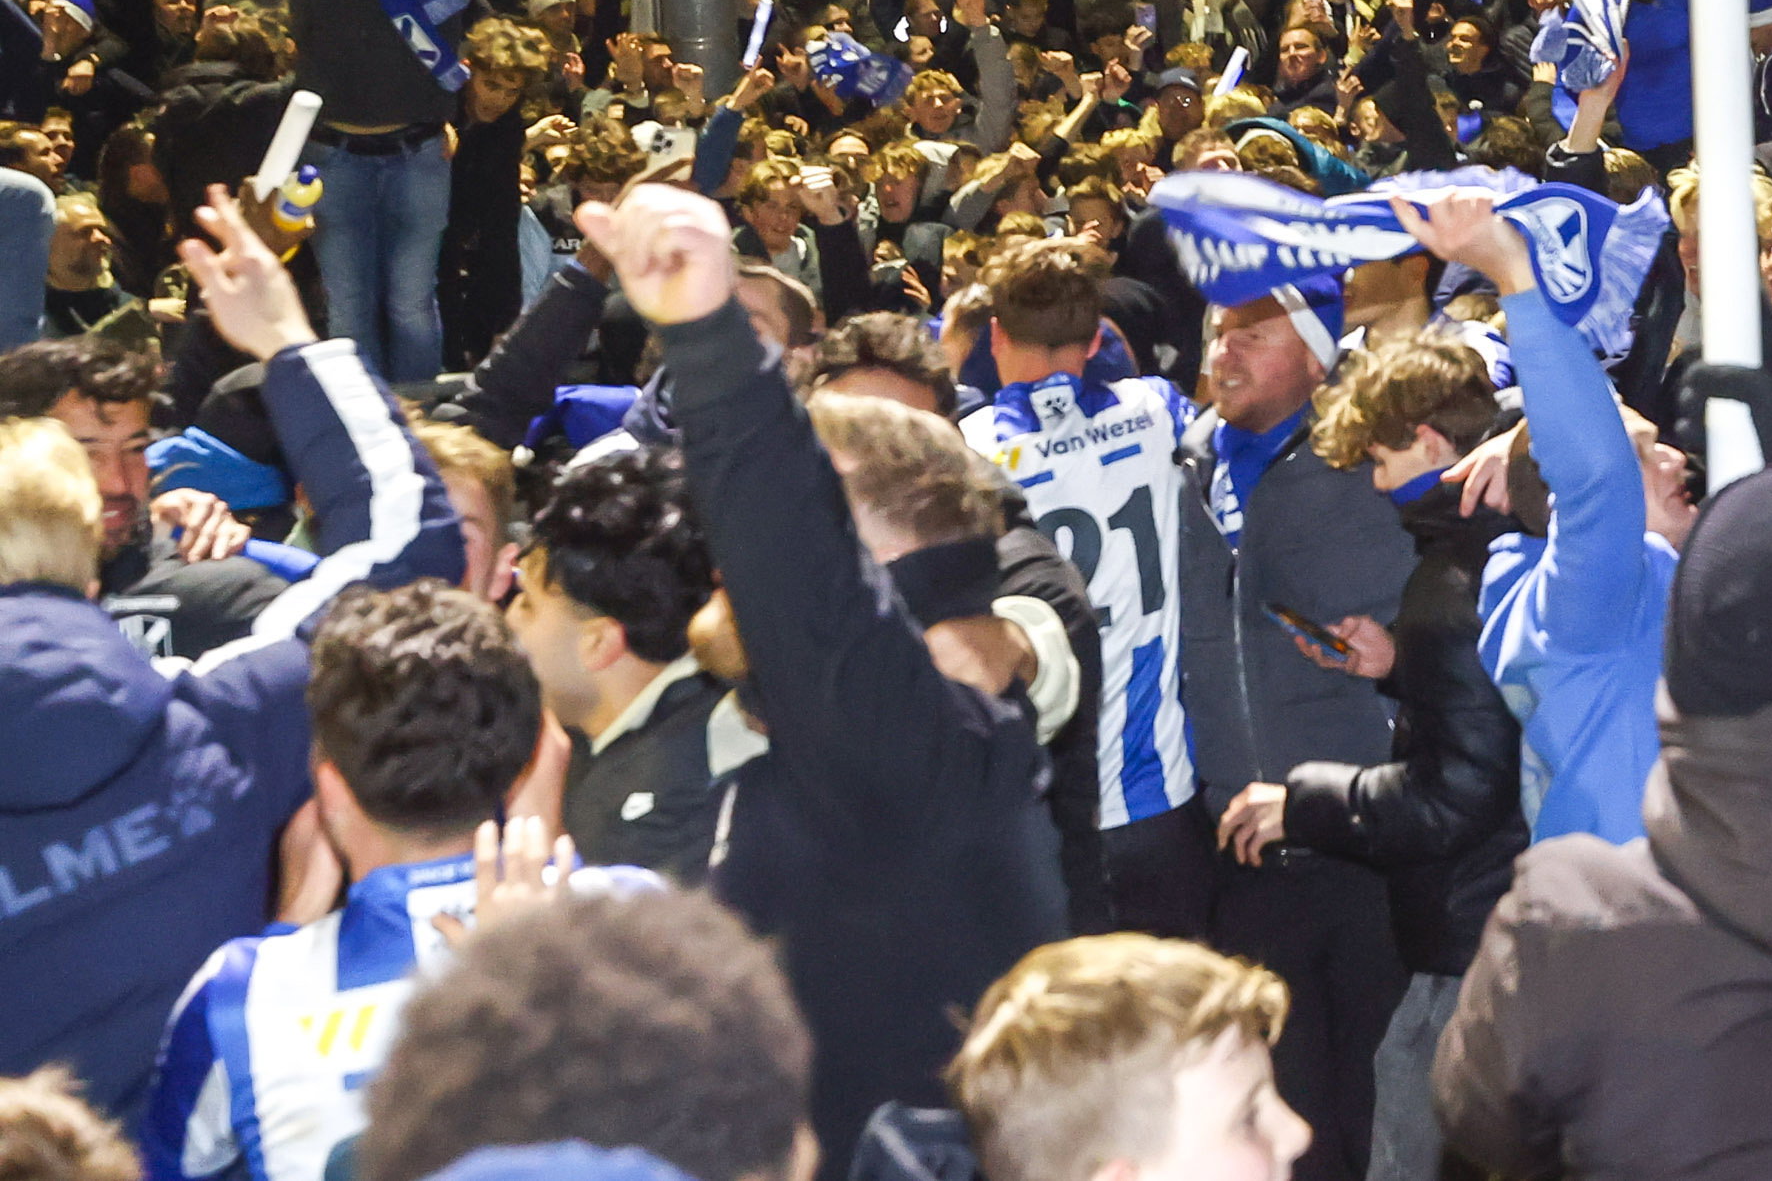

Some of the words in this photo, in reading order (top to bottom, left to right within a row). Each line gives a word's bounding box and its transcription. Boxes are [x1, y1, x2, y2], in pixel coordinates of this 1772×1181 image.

[1035, 435, 1086, 458] Van
[1085, 410, 1155, 444] Wezel
[1037, 483, 1165, 629] 21
